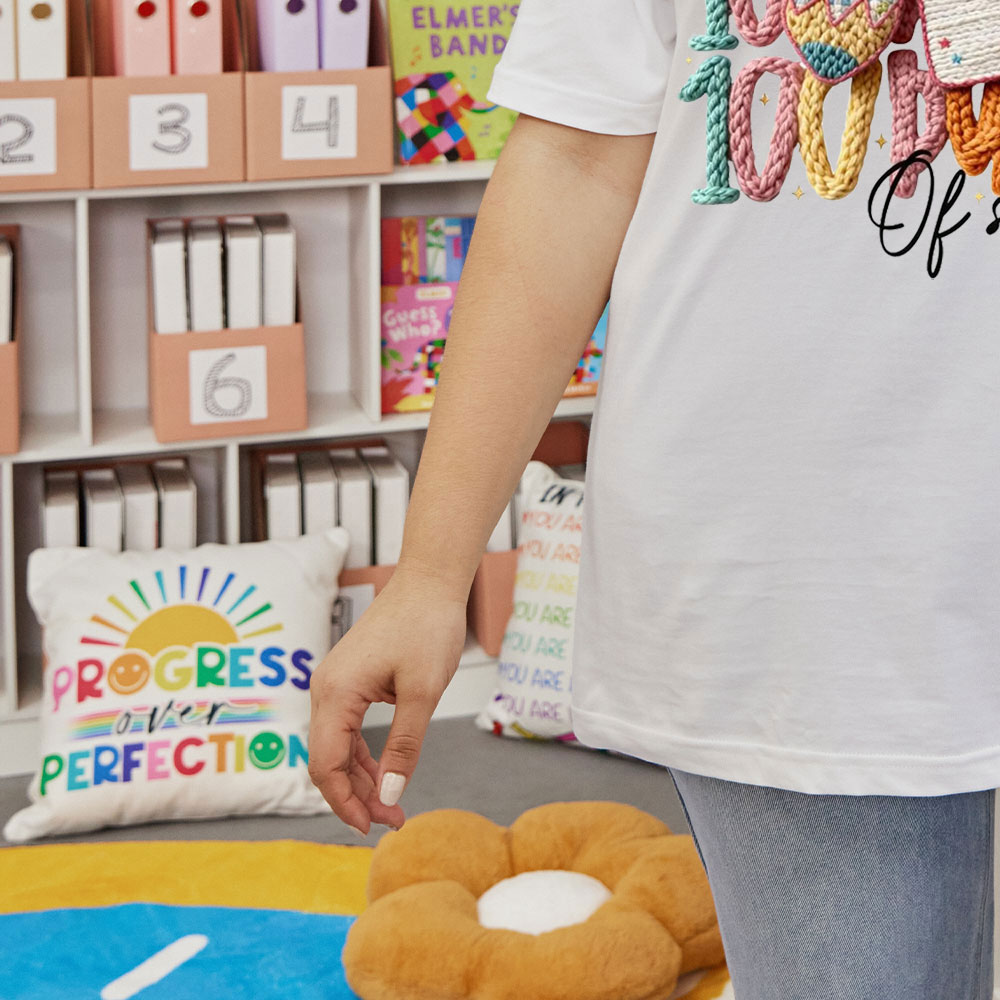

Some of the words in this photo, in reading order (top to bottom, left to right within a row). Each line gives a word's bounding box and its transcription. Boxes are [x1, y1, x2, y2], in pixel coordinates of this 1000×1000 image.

[429, 34, 508, 59] BAND
[0, 114, 34, 163] 2
[152, 102, 192, 155] 3
[291, 95, 339, 149] 4
[868, 150, 971, 280] Of
[383, 307, 437, 327] Guess
[388, 319, 442, 343] Who?
[204, 352, 252, 417] 6
[540, 607, 575, 628] ARE
[534, 636, 568, 659] ARE
[52, 646, 313, 713] PROGRESS
[531, 667, 566, 692] ARE
[115, 700, 232, 735] over
[529, 700, 563, 721] ARE
[39, 730, 310, 797] PERFECTION
